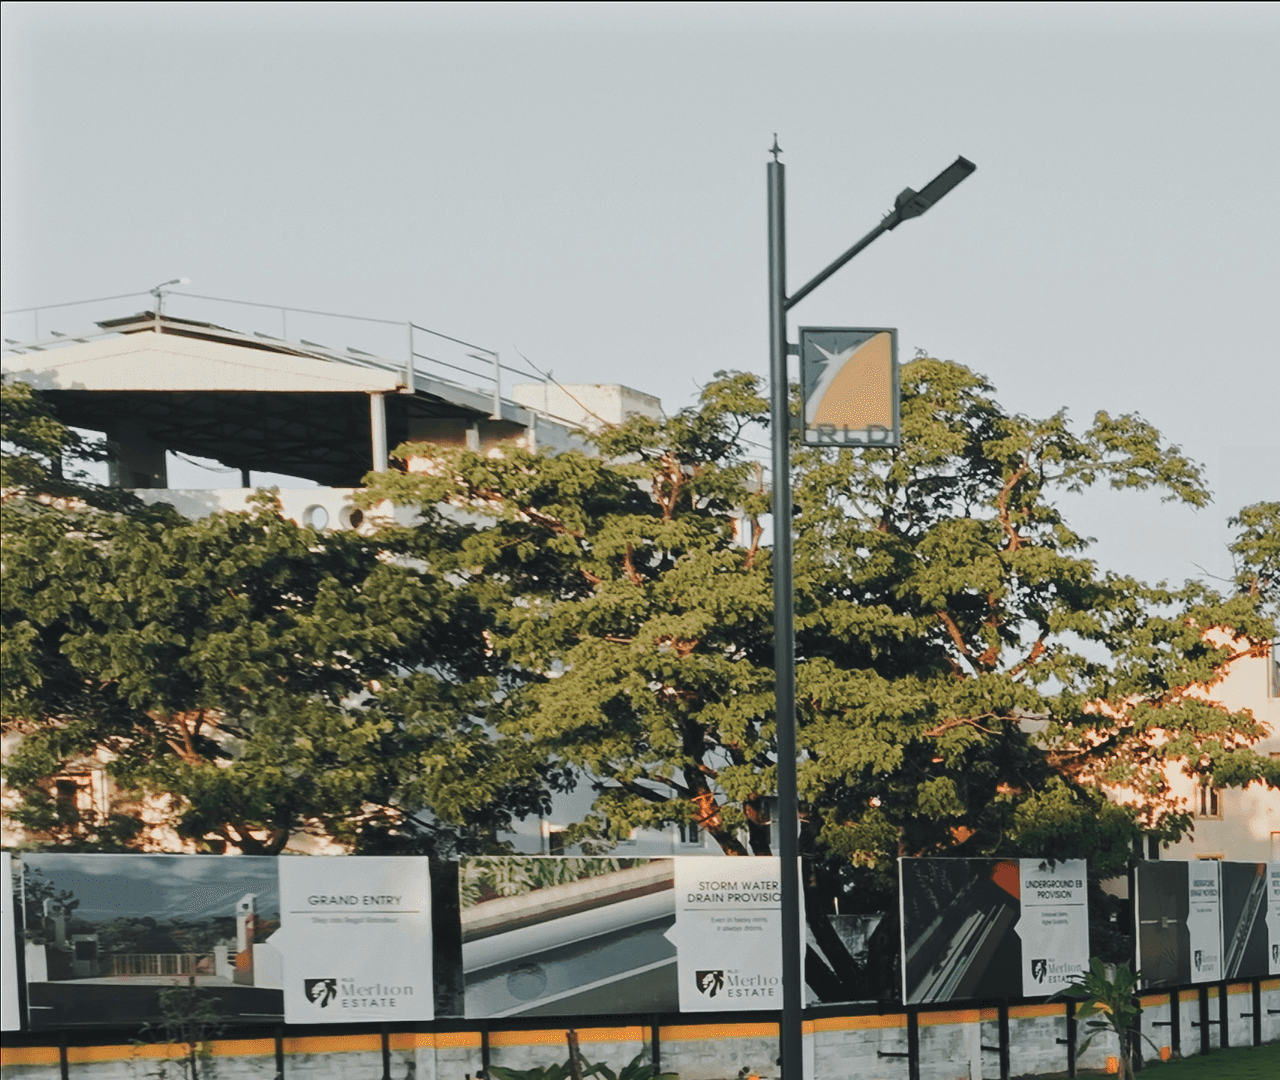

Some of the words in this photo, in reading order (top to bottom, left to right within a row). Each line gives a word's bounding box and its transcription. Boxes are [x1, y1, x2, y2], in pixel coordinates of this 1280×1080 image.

[816, 423, 889, 443] RLD
[698, 881, 738, 891] STORM
[741, 881, 779, 890] WATER
[1025, 879, 1074, 889] UNDERGROUND
[687, 893, 724, 903] DRAIN
[727, 892, 782, 902] PROVISIO
[1037, 890, 1073, 899] PROVISION
[307, 895, 359, 906] GRAND
[362, 895, 402, 906] ENTRY
[727, 974, 780, 987] Merlio
[341, 983, 414, 997] Merlion
[727, 987, 774, 998] ESTATE
[341, 998, 397, 1008] ESTATE
